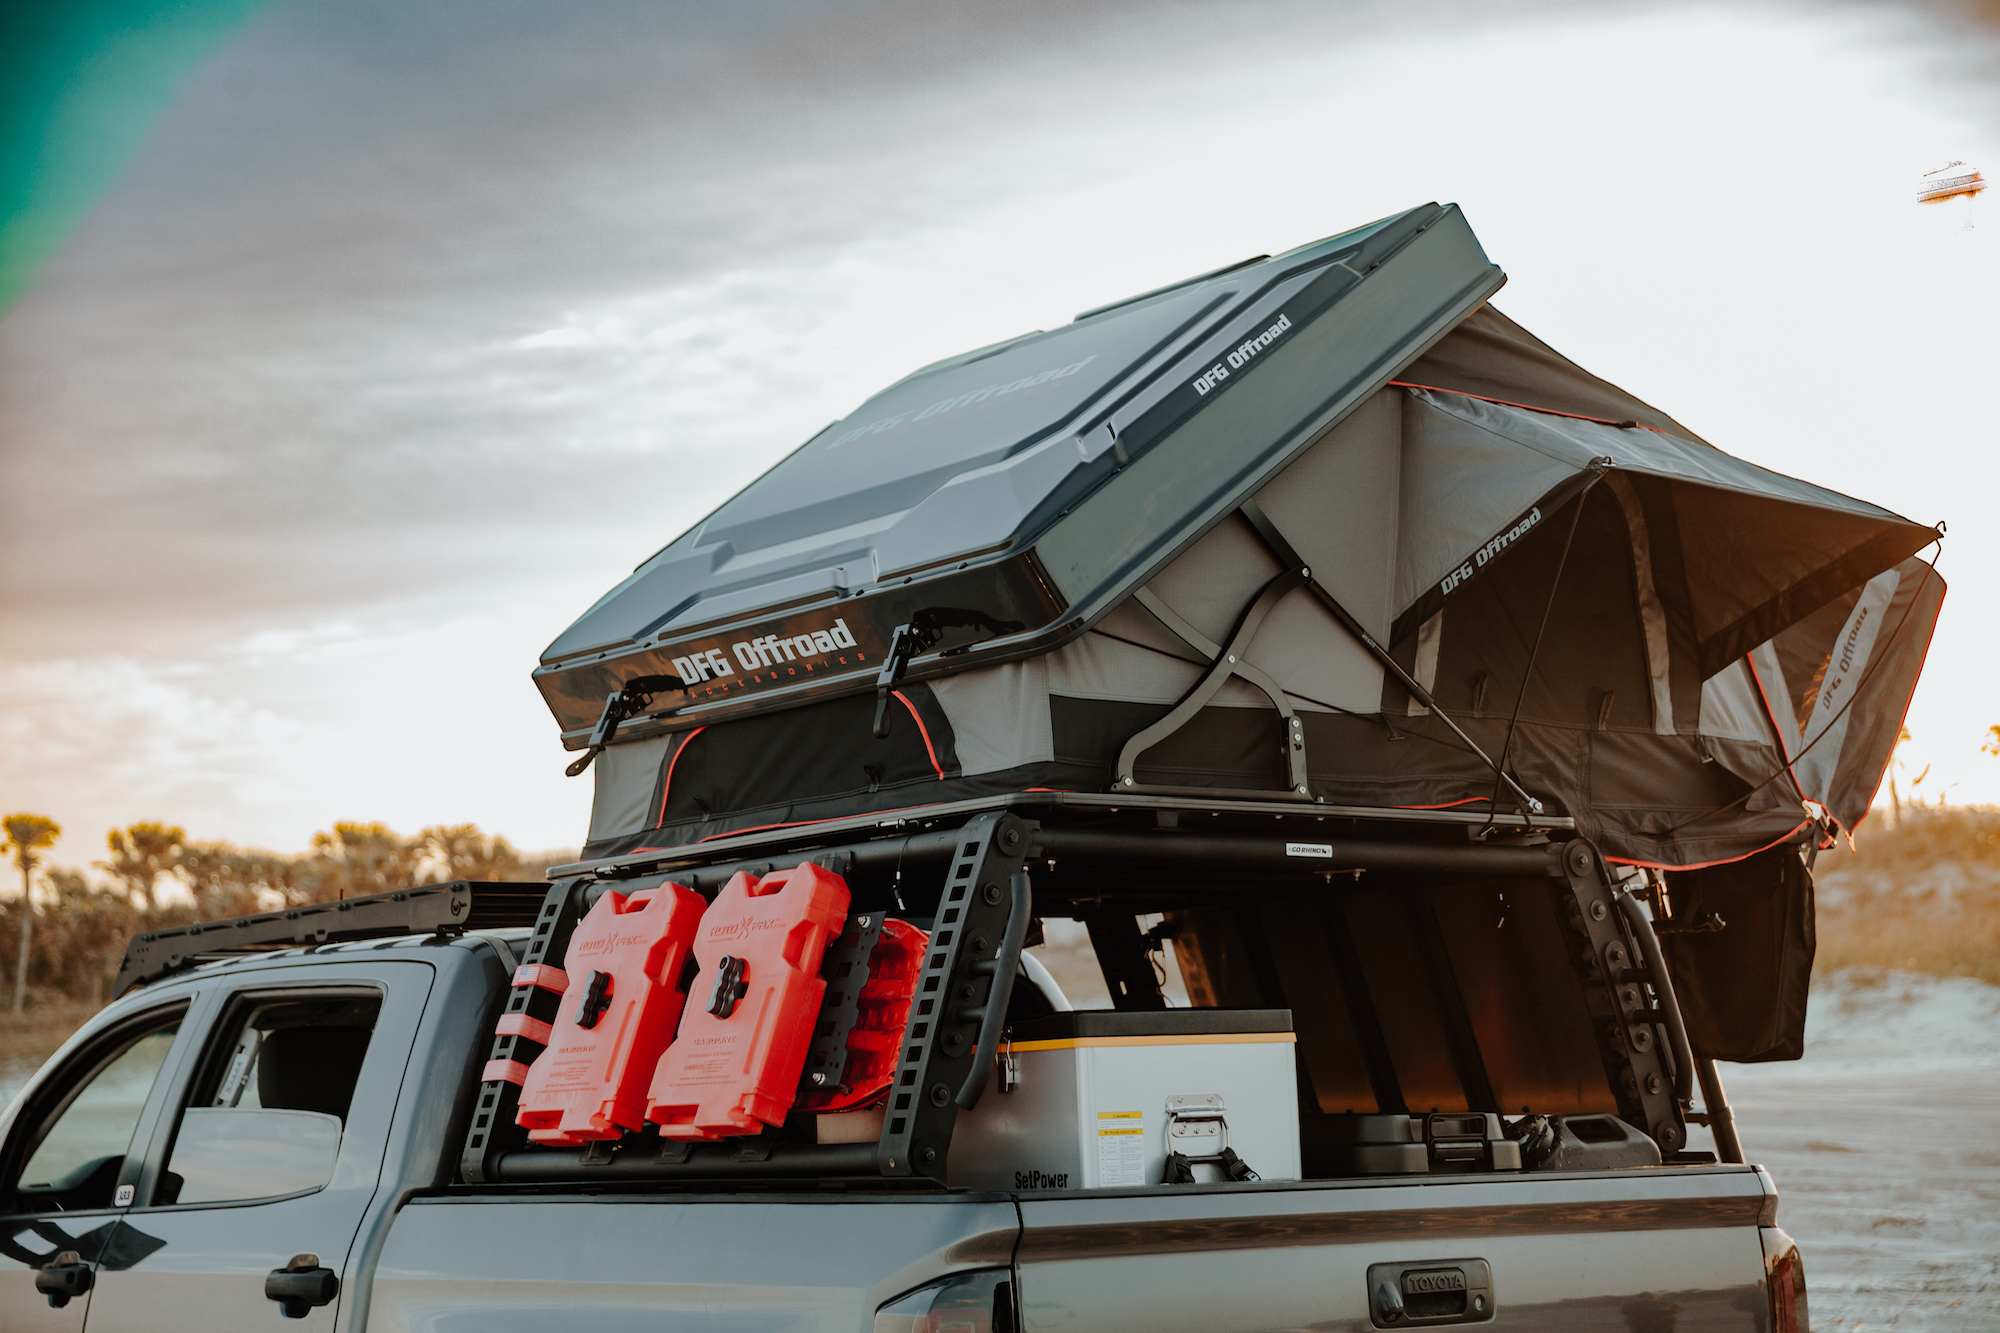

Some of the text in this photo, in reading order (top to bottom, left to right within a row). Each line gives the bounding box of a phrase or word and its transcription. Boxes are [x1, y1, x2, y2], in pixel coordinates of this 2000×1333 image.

[912, 353, 1098, 422] Offroad
[1192, 312, 1292, 396] DFG Offroad
[1440, 561, 1474, 596] DFG
[1475, 506, 1542, 568] Offroad
[671, 617, 858, 686] DFG Offroad
[1839, 606, 1868, 674] Offroad
[691, 652, 866, 699] ACCESSORIES
[1014, 1170, 1069, 1190] SetPower
[1409, 1274, 1464, 1292] TOYOTA
